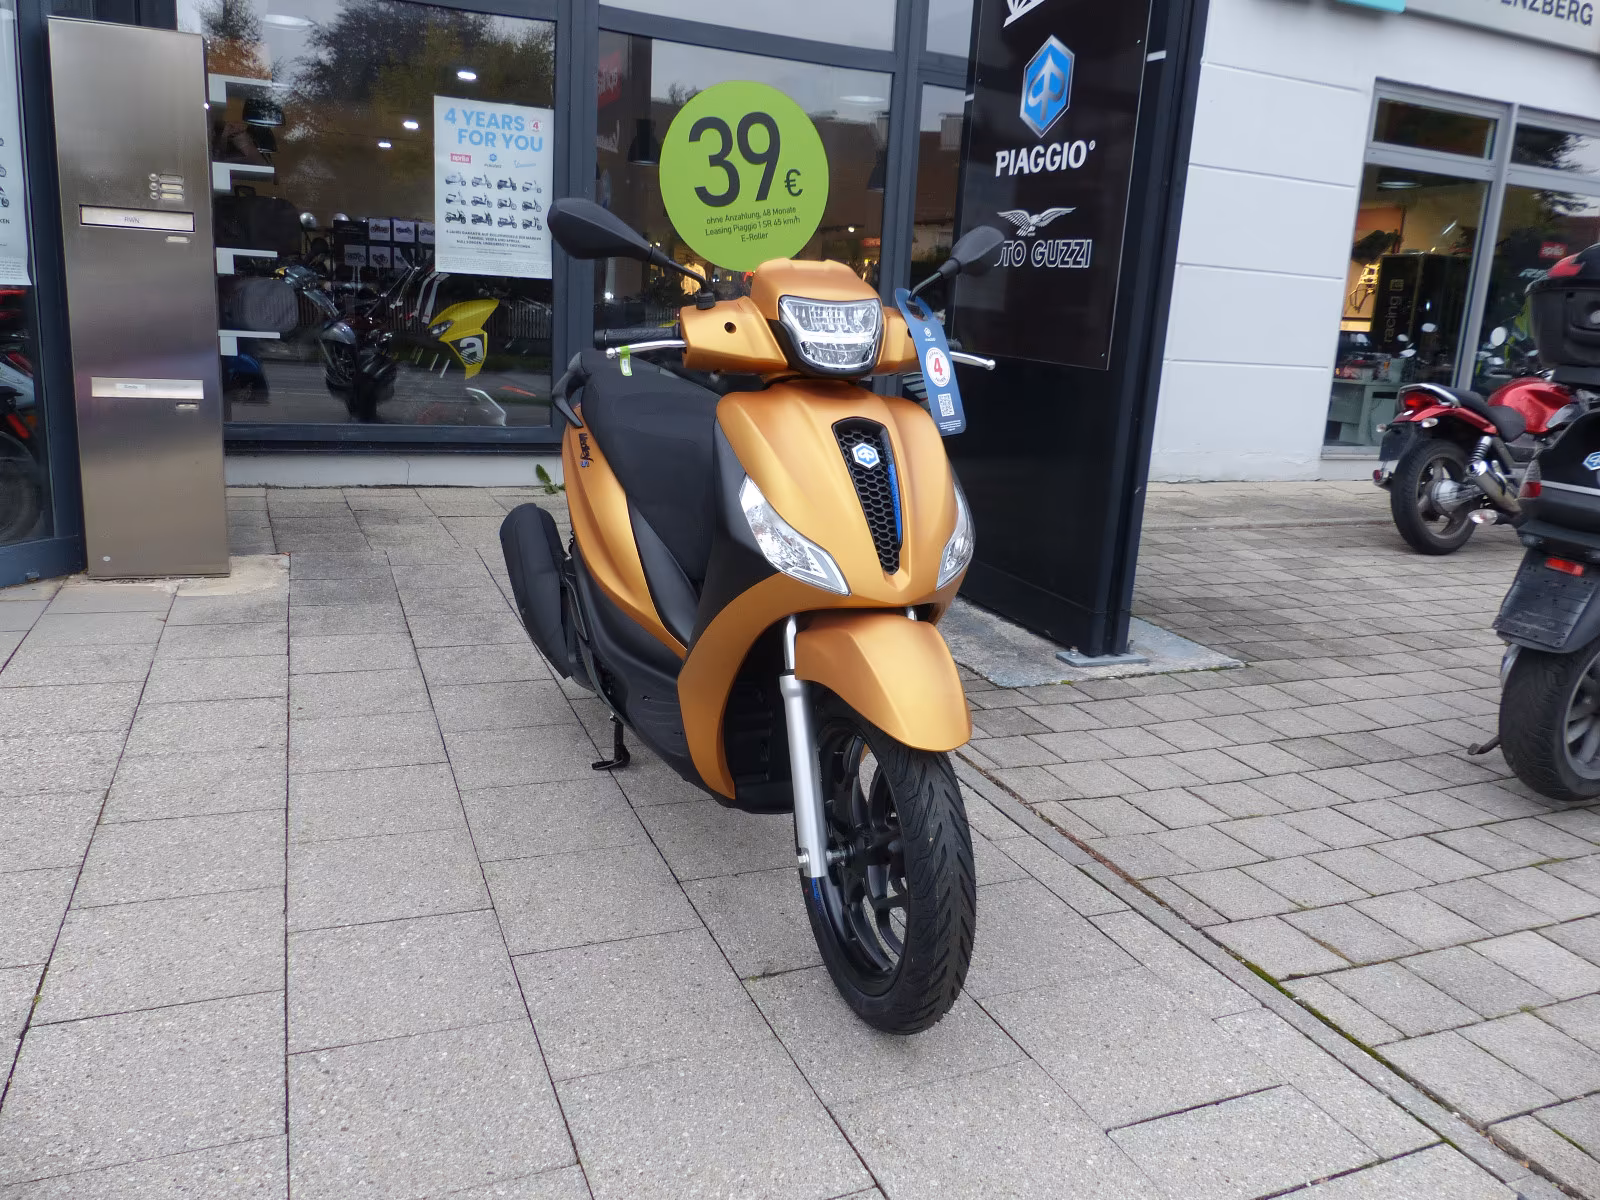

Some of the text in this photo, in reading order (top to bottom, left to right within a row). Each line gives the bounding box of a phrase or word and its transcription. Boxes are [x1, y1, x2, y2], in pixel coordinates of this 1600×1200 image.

[1497, 0, 1593, 26] ZBERG
[444, 107, 525, 132] 4 YEARS
[457, 128, 543, 153] FOR YOU
[688, 111, 803, 208] 39 €
[705, 226, 732, 236] Leasing
[733, 222, 757, 233] Piaggio
[762, 219, 772, 228] SR
[773, 218, 782, 226] 45
[783, 215, 801, 225] km/h
[706, 206, 796, 224] ohne Anzahlung, 48 Monate
[740, 232, 769, 242] E-Roller
[994, 239, 1093, 268] TO GUZZI
[934, 357, 943, 376] 4
